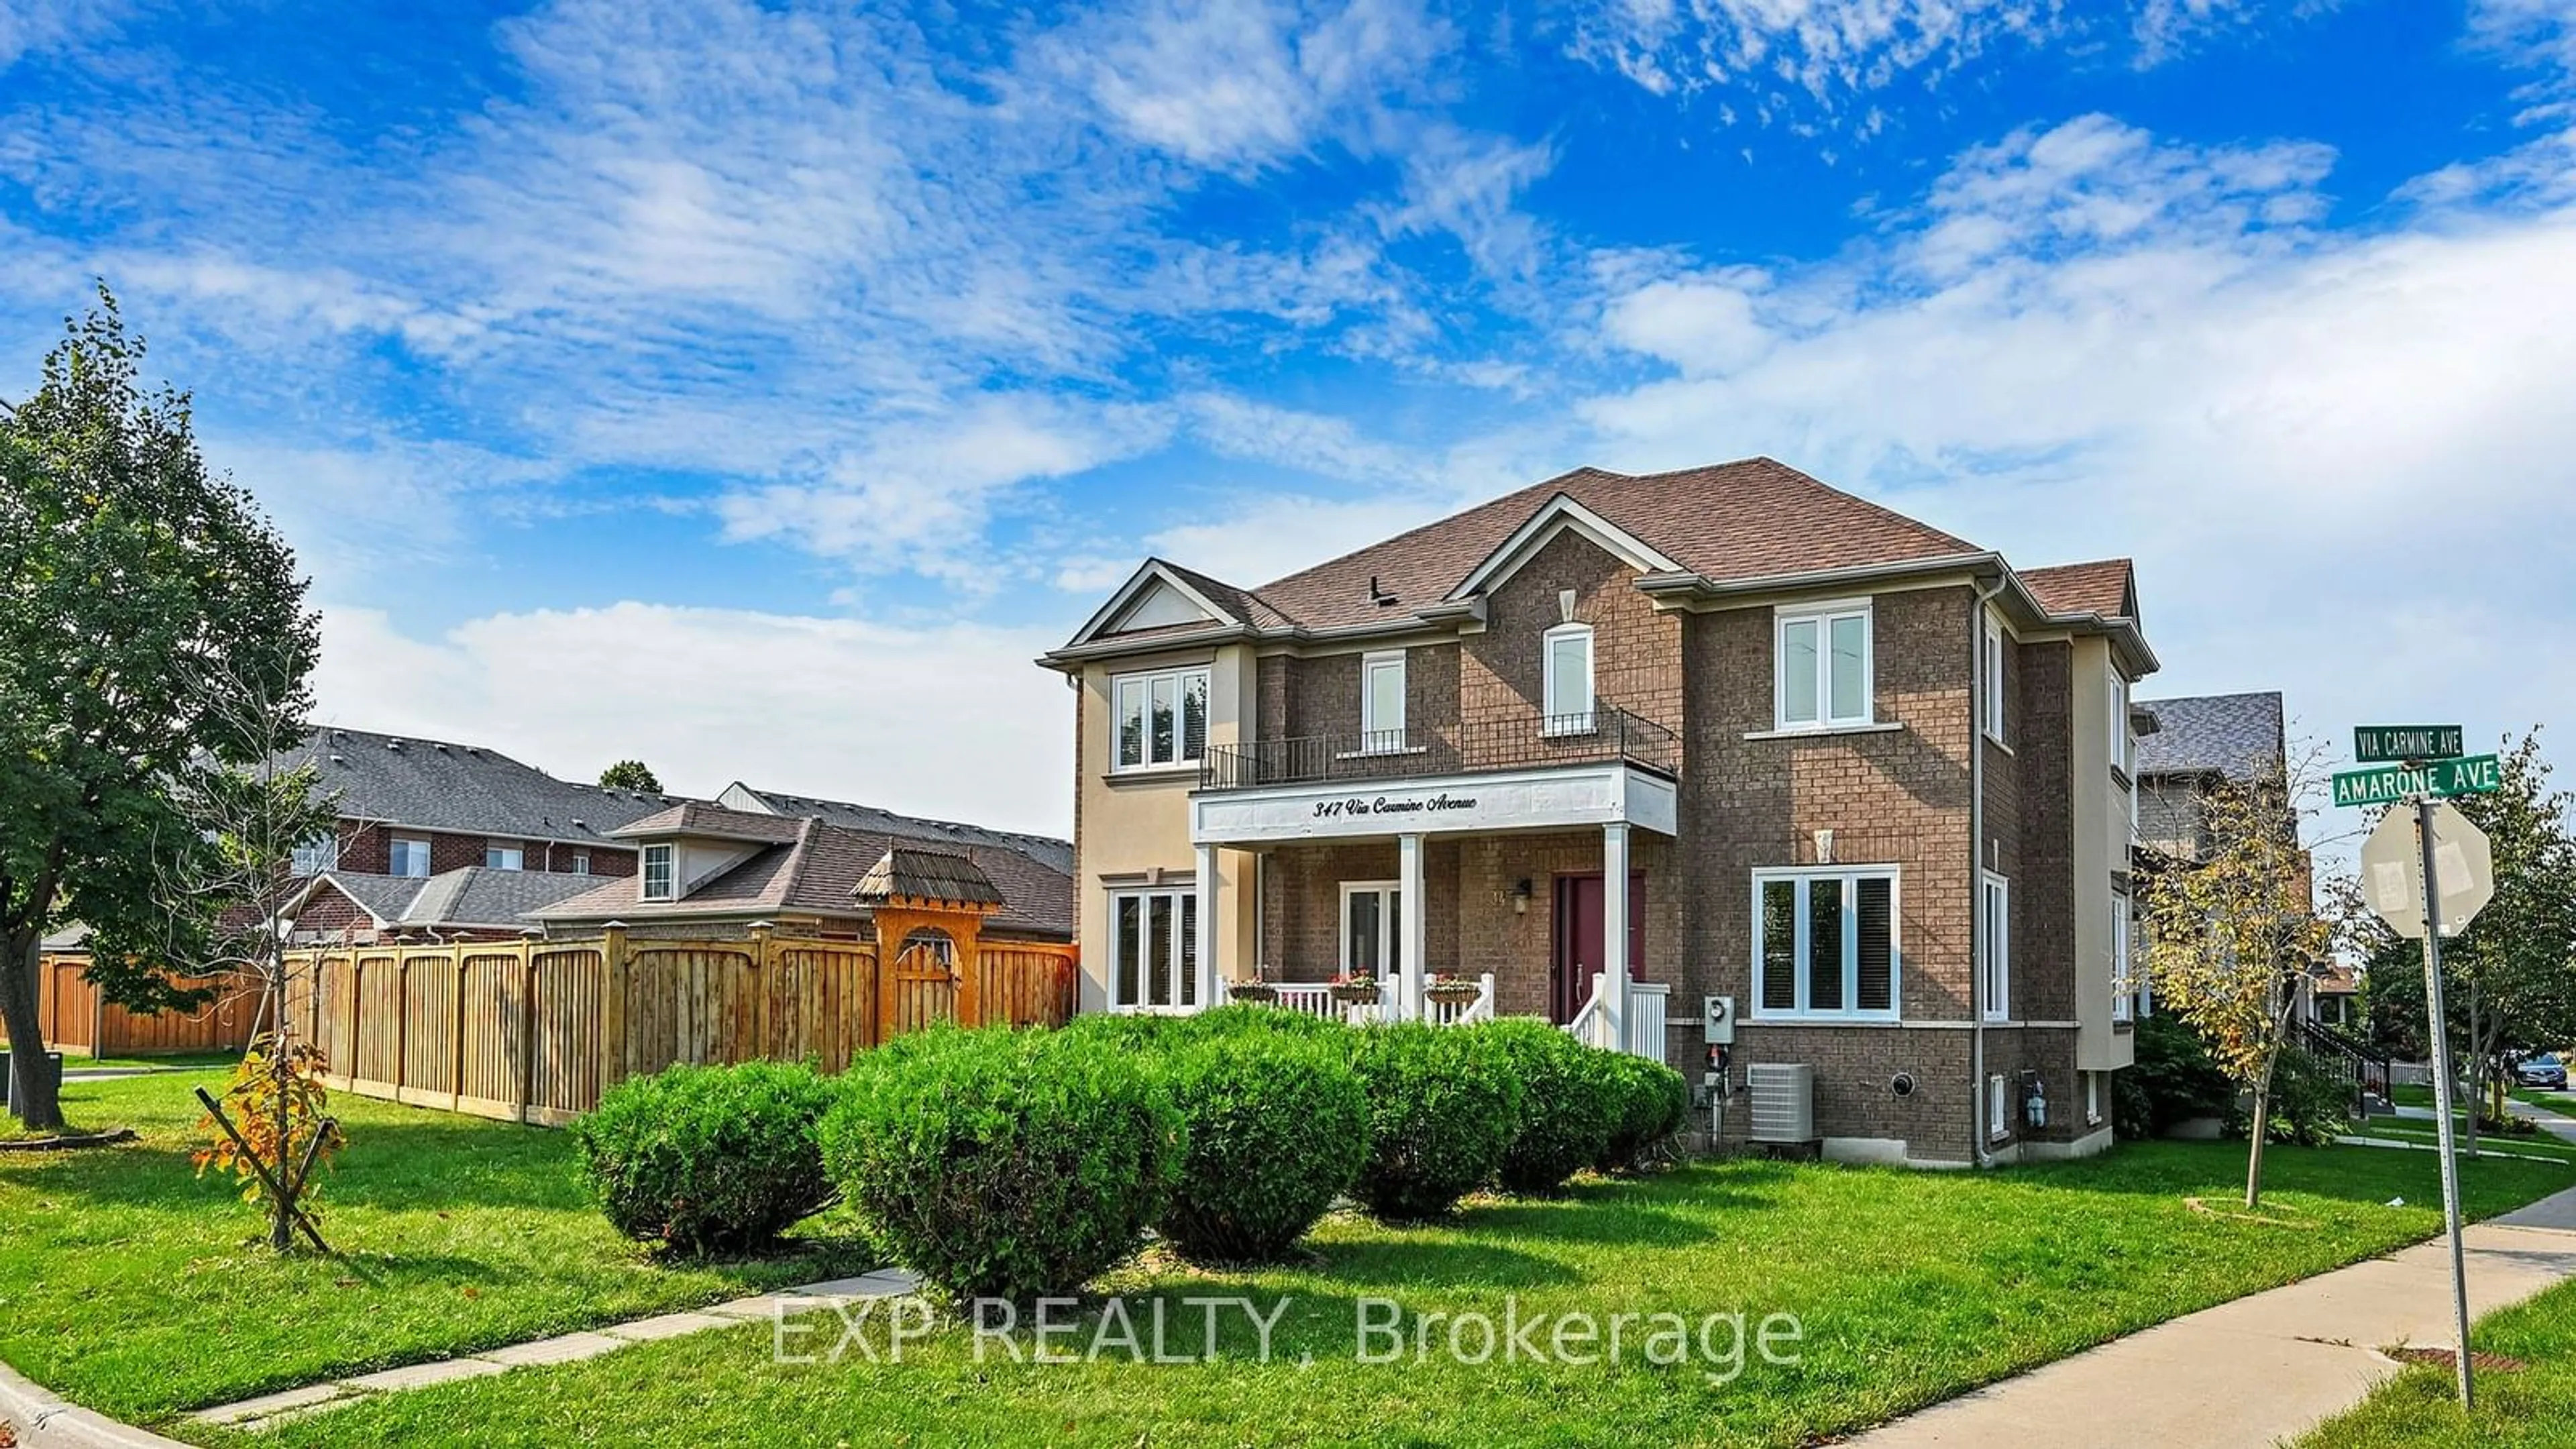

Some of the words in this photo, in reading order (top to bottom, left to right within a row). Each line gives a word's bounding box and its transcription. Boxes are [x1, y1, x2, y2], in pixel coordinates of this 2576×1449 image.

[2358, 733, 2379, 757] VIA
[2385, 731, 2435, 756] CARMINE
[2440, 731, 2461, 755] AVE
[2338, 767, 2440, 802] AMARONE
[2453, 760, 2497, 789] AVE
[1313, 802, 1344, 817] 347
[1346, 798, 1369, 815] Via
[1373, 797, 1424, 814] Carmine
[1427, 794, 1477, 811] Avenue
